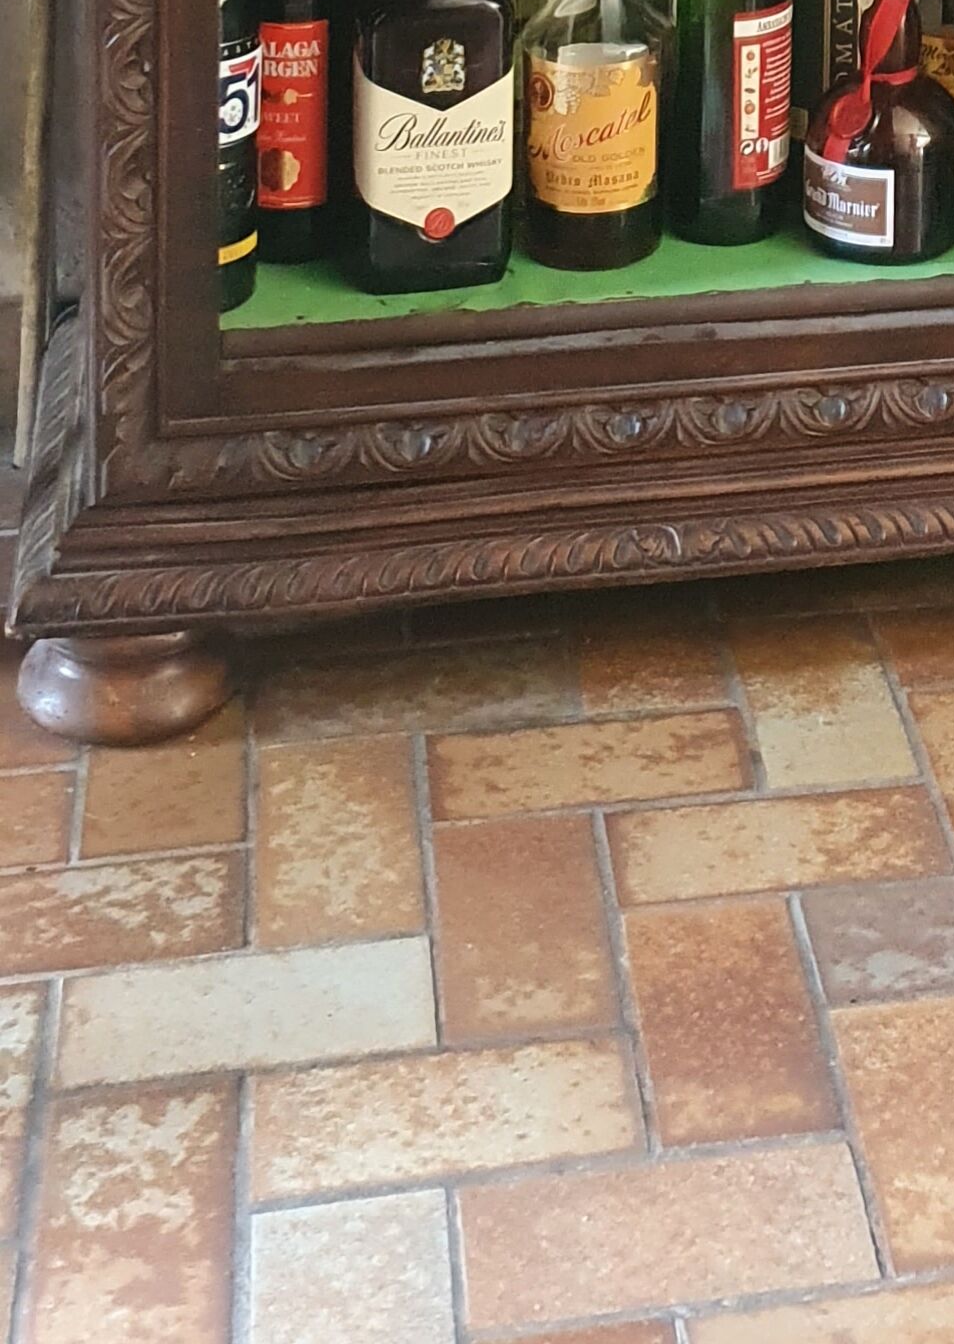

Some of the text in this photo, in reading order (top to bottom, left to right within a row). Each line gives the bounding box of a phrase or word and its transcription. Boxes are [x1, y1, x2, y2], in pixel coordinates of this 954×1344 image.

[375, 112, 506, 152] Ballantine's
[529, 90, 652, 161] Moscatel
[377, 158, 503, 175] BLENDED SCOTCH WHISKY
[415, 148, 468, 160] FINEST
